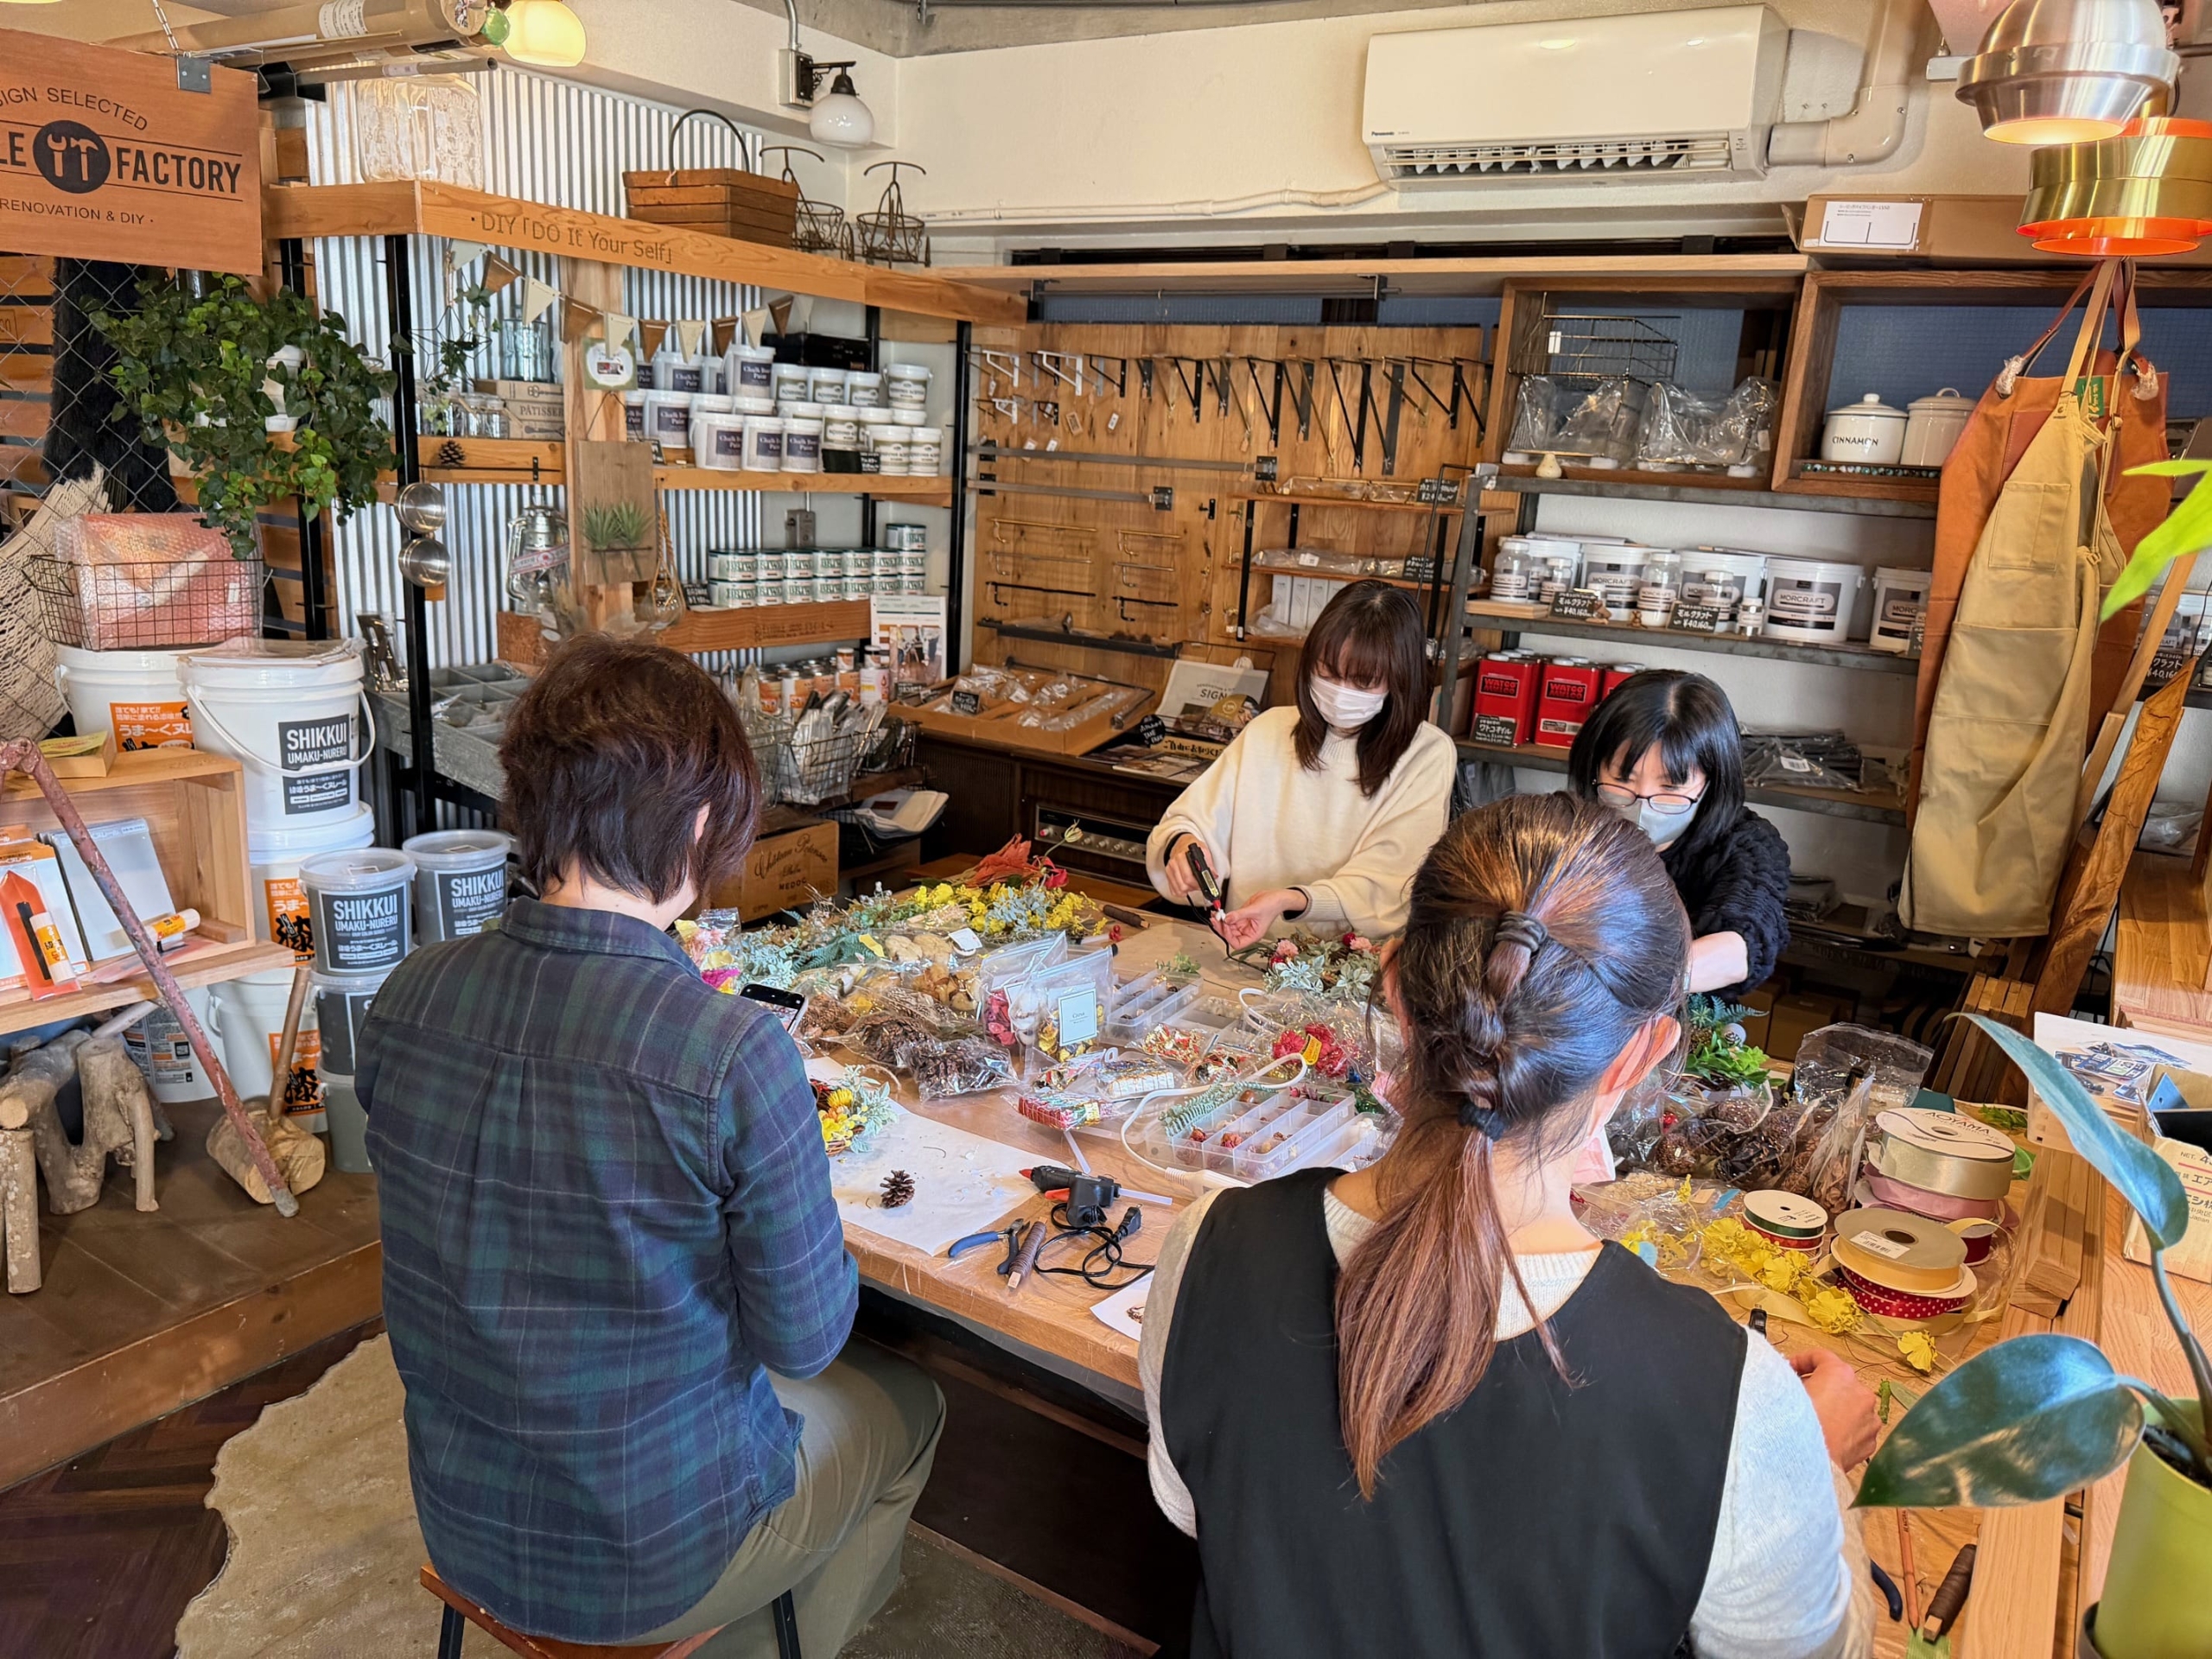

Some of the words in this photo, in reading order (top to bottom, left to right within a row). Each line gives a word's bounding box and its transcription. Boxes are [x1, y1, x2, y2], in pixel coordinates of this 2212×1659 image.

[47, 87, 149, 131] SELECTED
[116, 147, 241, 194] FACTORY
[0, 198, 100, 221] RENOVATION
[105, 210, 115, 222] &
[120, 212, 145, 226] DIY
[481, 211, 516, 235] DIY
[568, 227, 583, 247] It
[588, 230, 628, 255] Your
[1832, 436, 1879, 447] CINNAMON
[1592, 576, 1634, 585] MORCRAFT
[1780, 594, 1826, 604] MORCRAFT
[1892, 605, 1918, 614] MORC
[2152, 658, 2183, 669] クラフト
[1484, 677, 1516, 689] WATCO
[1549, 683, 1583, 693] WATCO
[1199, 688, 1228, 701] SIGN
[118, 721, 193, 737] うま〜くヌレ
[286, 721, 347, 751] SHIKKUI
[287, 745, 347, 765] UMAKU-NURERU
[450, 868, 505, 898] SHIKKUI
[779, 876, 808, 891] MEDOC
[333, 893, 397, 920] SHIKKUI
[334, 914, 398, 932] UMAKU-NURERU
[1924, 1111, 1990, 1135] AOYAMA
[2191, 1173, 2212, 1186] エア
